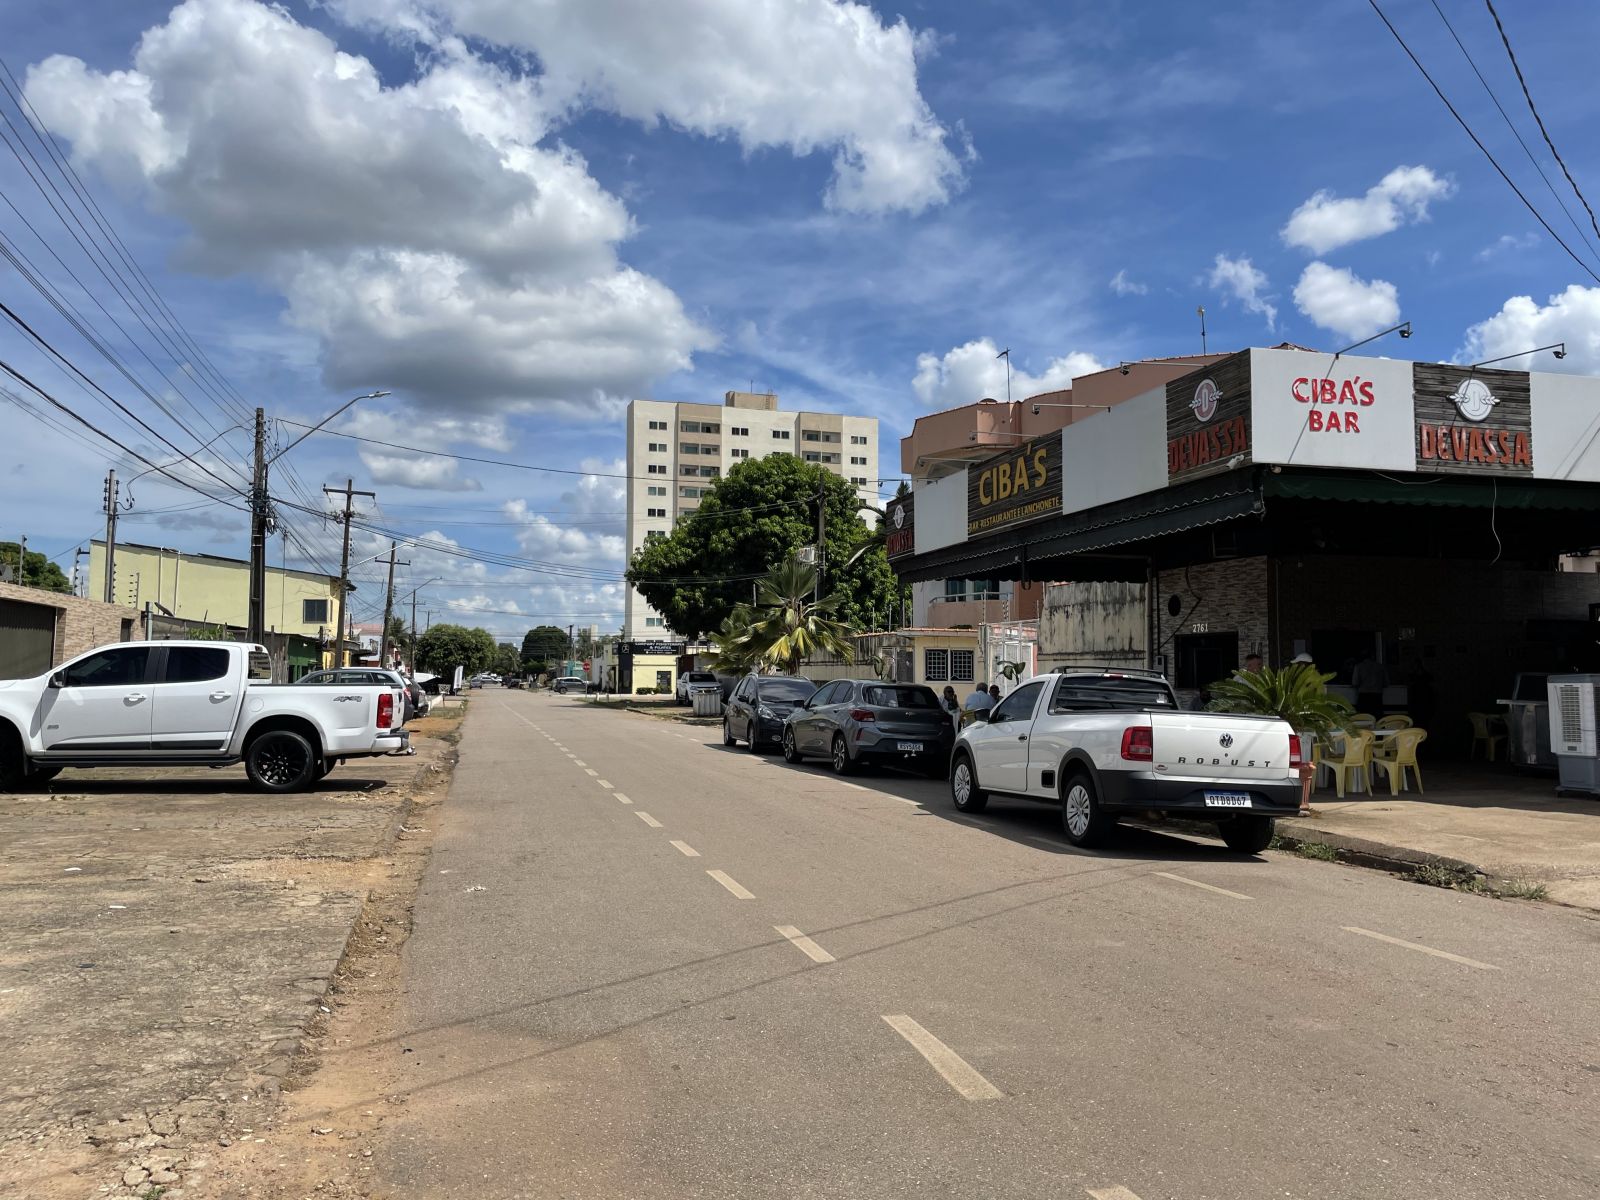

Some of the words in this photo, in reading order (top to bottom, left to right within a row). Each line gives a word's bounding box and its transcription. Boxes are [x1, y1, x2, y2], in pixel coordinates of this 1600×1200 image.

[1291, 375, 1375, 407] CIBA'S
[1308, 409, 1361, 434] BAR
[1167, 415, 1248, 474] DEVASSA
[1420, 423, 1532, 465] DEVASSA
[979, 442, 1047, 506] CIBA'S
[1192, 623, 1208, 633] 2761
[1177, 756, 1271, 768] ROBUST
